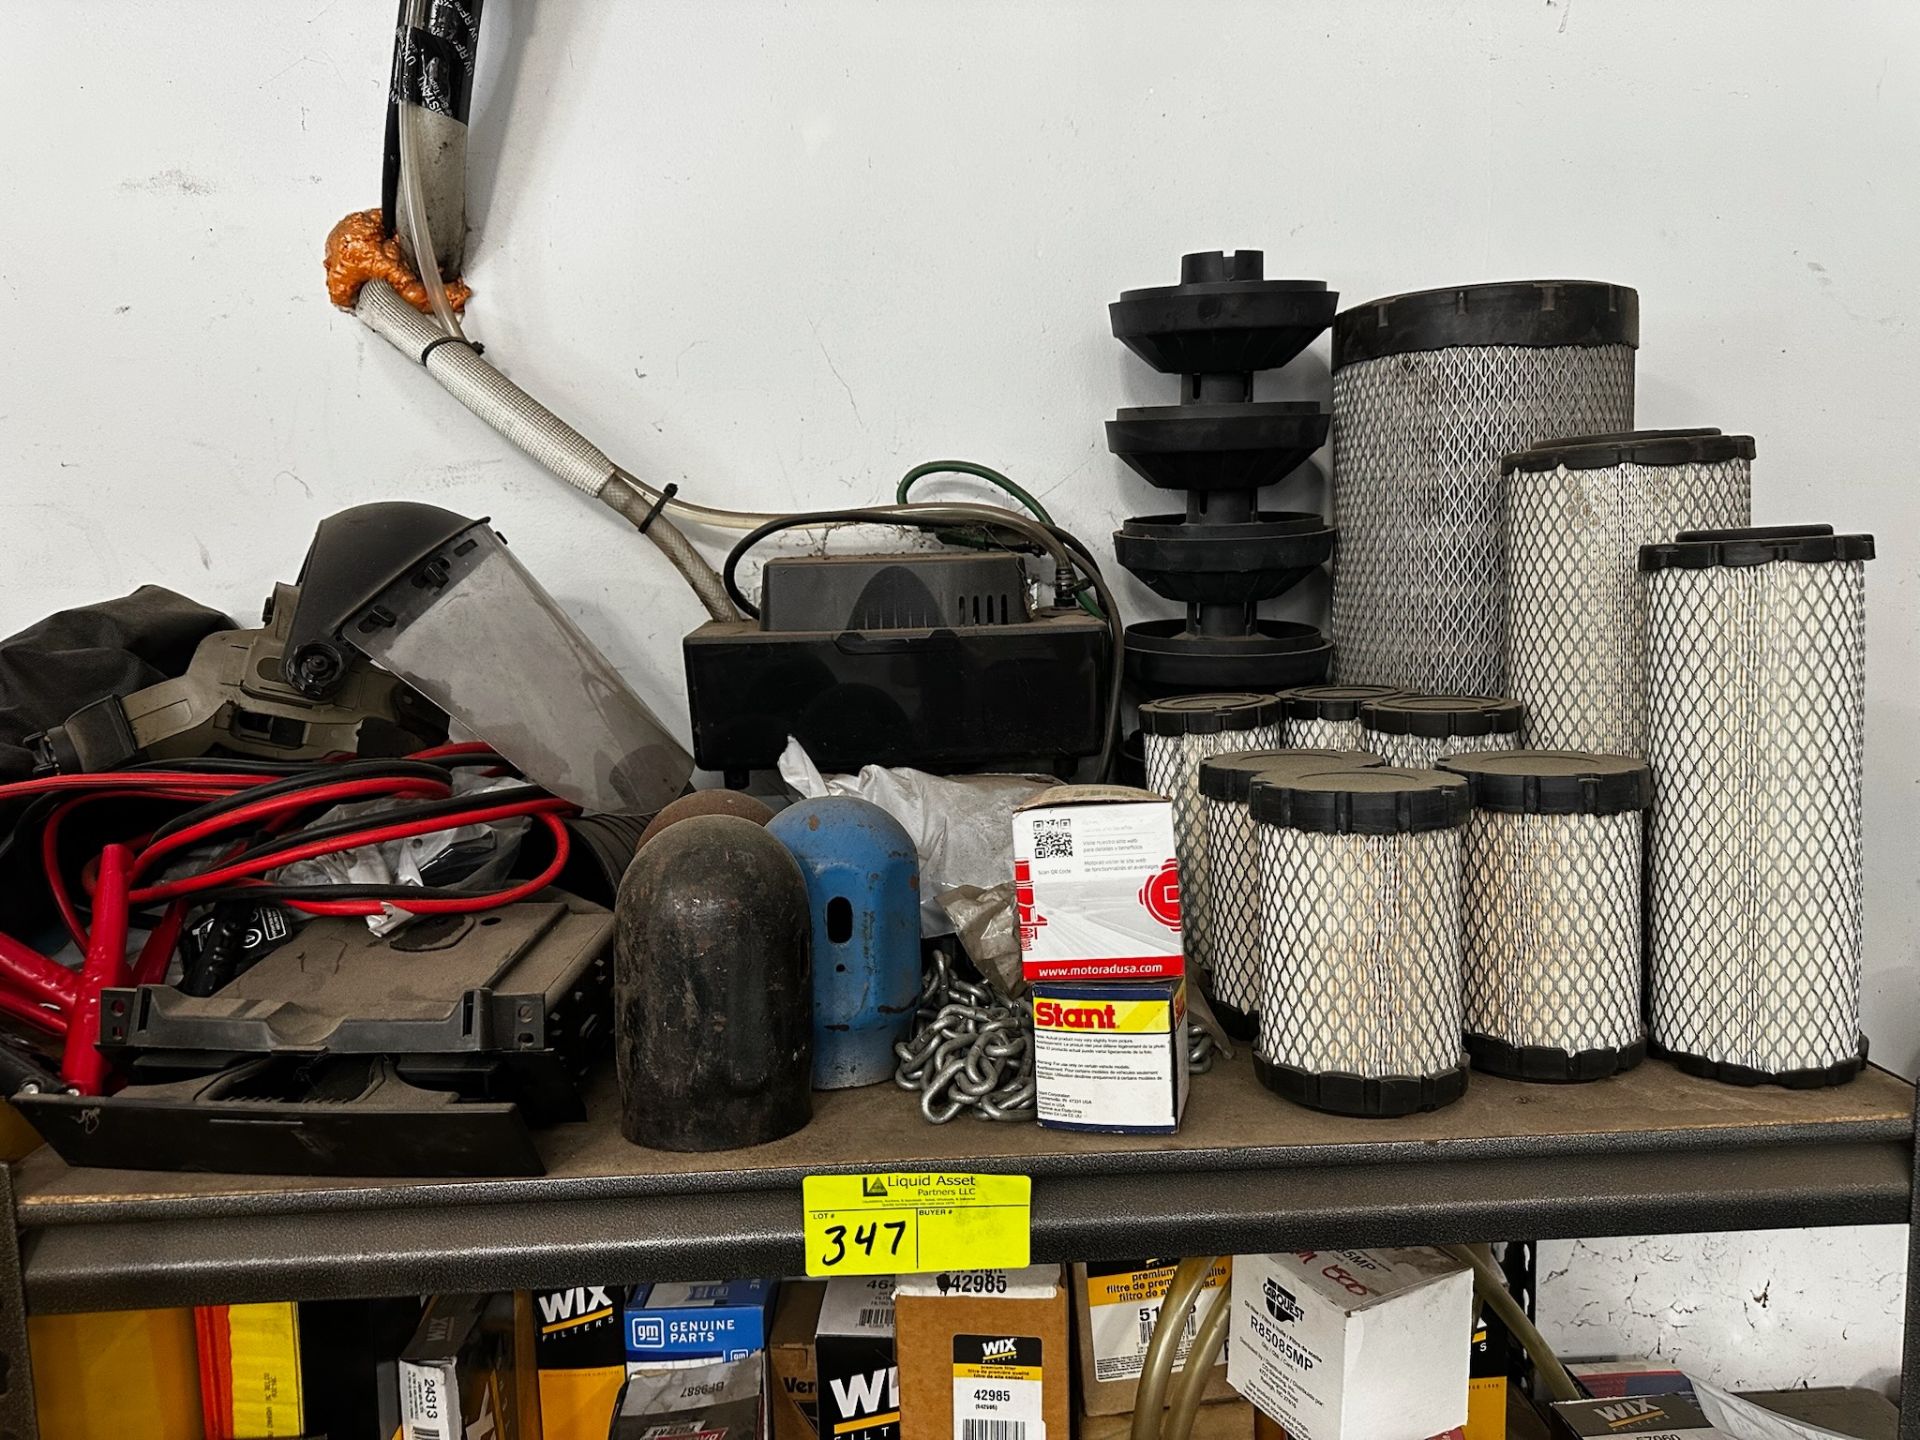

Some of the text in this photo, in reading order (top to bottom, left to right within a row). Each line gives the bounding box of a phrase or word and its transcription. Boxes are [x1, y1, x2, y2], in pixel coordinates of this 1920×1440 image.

[1039, 964, 1163, 977] www.motoradusa.com
[1035, 1002, 1117, 1029] Stant
[888, 1175, 977, 1189] Liquid Asset
[918, 1188, 977, 1197] Partners LLC
[822, 1220, 907, 1267] 347
[1131, 1268, 1177, 1283] premium
[1106, 1285, 1130, 1295] filtre
[1133, 1281, 1145, 1291] de
[1148, 1278, 1173, 1290] prem
[1119, 1291, 1143, 1302] filtro
[1146, 1289, 1158, 1298] de
[539, 1286, 613, 1323] WIX
[1262, 1282, 1305, 1322] CARQUEST
[542, 1316, 614, 1342] FILTERS
[638, 1325, 659, 1341] gm
[669, 1320, 735, 1333] GENUINE
[670, 1332, 715, 1344] PARTS
[982, 1338, 1017, 1356] WIX
[1250, 1314, 1314, 1371] R85085MP
[783, 1376, 818, 1394] Ver
[829, 1365, 900, 1419] WI
[424, 1378, 438, 1419] 24313
[974, 1389, 1011, 1402] 42985
[1593, 1398, 1661, 1421] WIX
